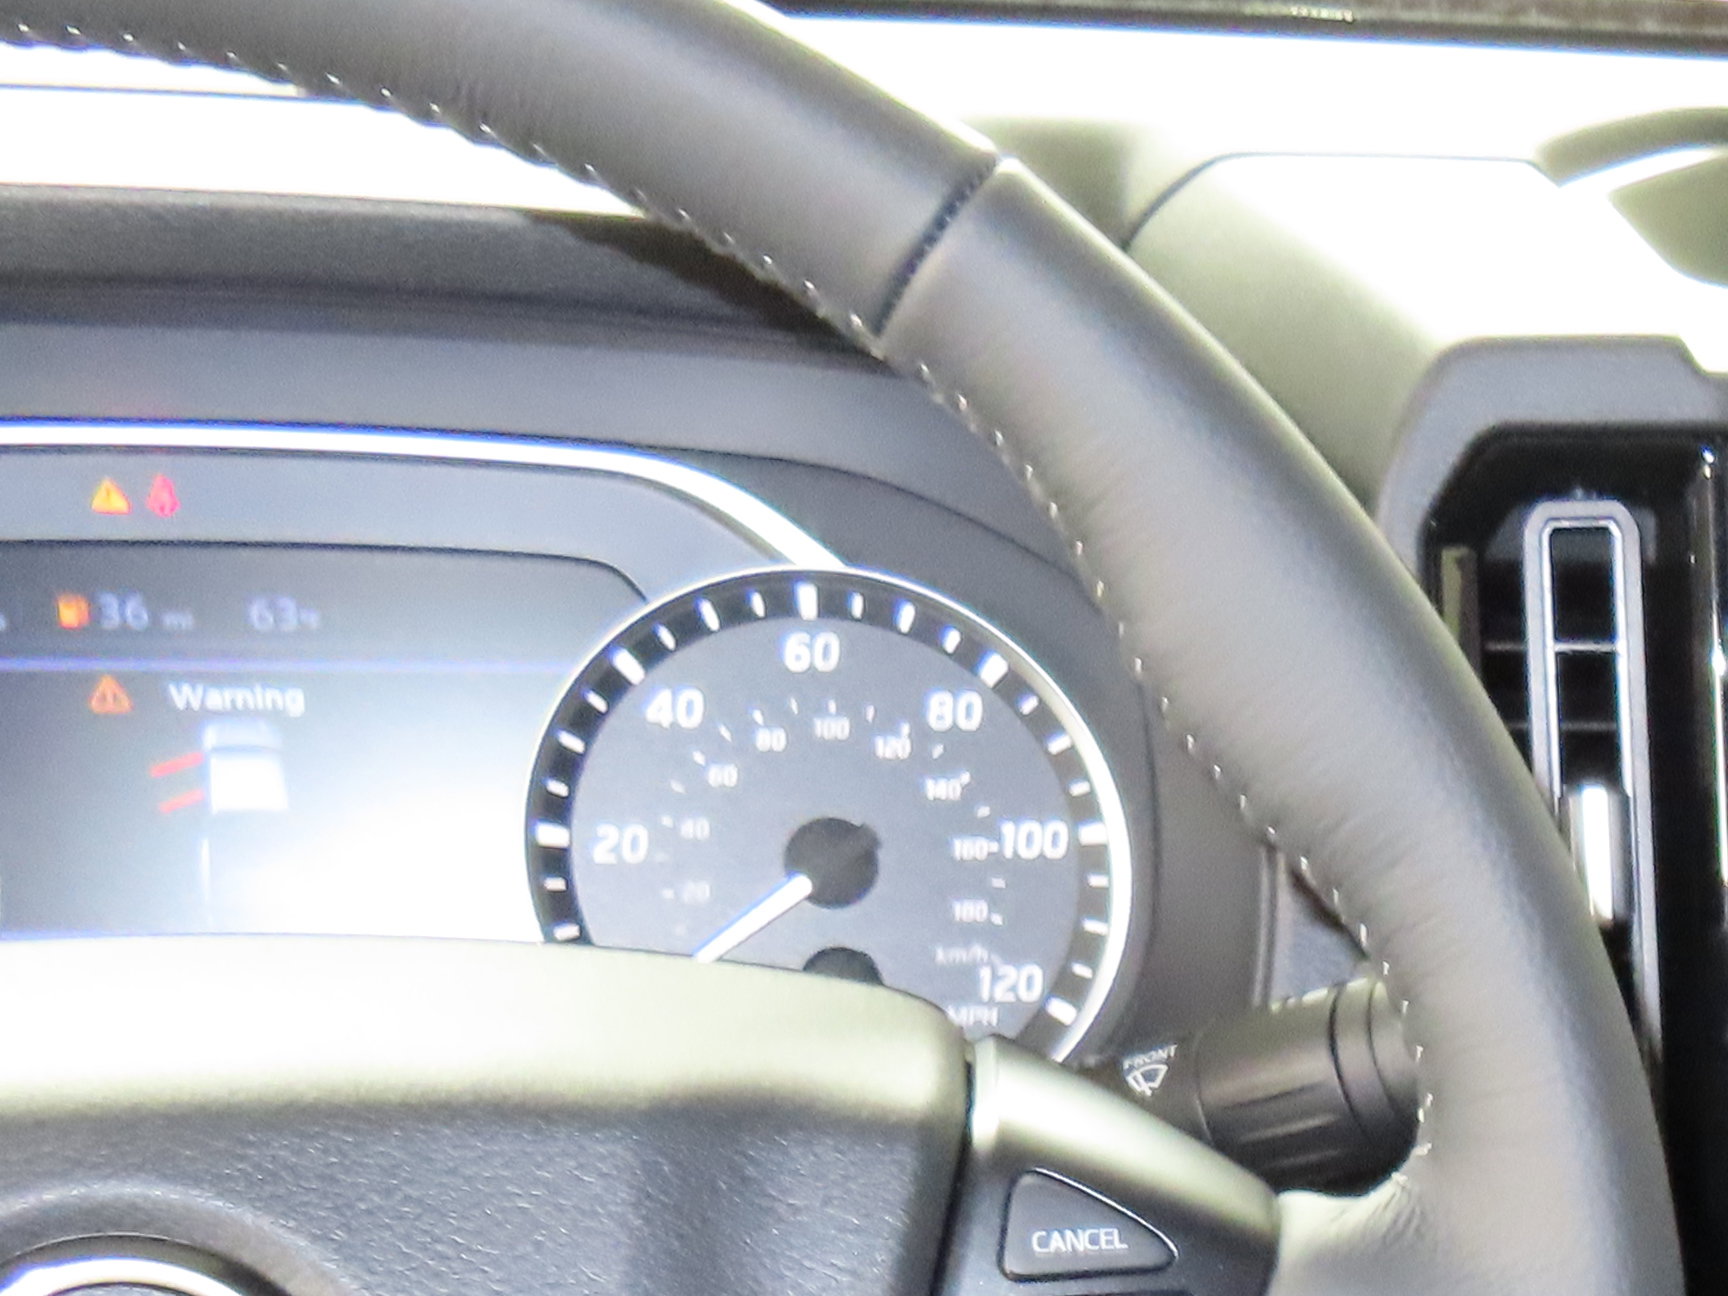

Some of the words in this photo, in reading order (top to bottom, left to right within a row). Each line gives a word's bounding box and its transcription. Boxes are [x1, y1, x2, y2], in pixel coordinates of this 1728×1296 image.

[782, 631, 840, 673] 60
[167, 681, 305, 718] Warning
[645, 687, 705, 729] 40
[926, 690, 983, 731] 80
[592, 823, 649, 865] 20
[1000, 820, 1069, 860] 100
[977, 963, 1044, 1003] 120
[1032, 1229, 1128, 1255] CANCEL
